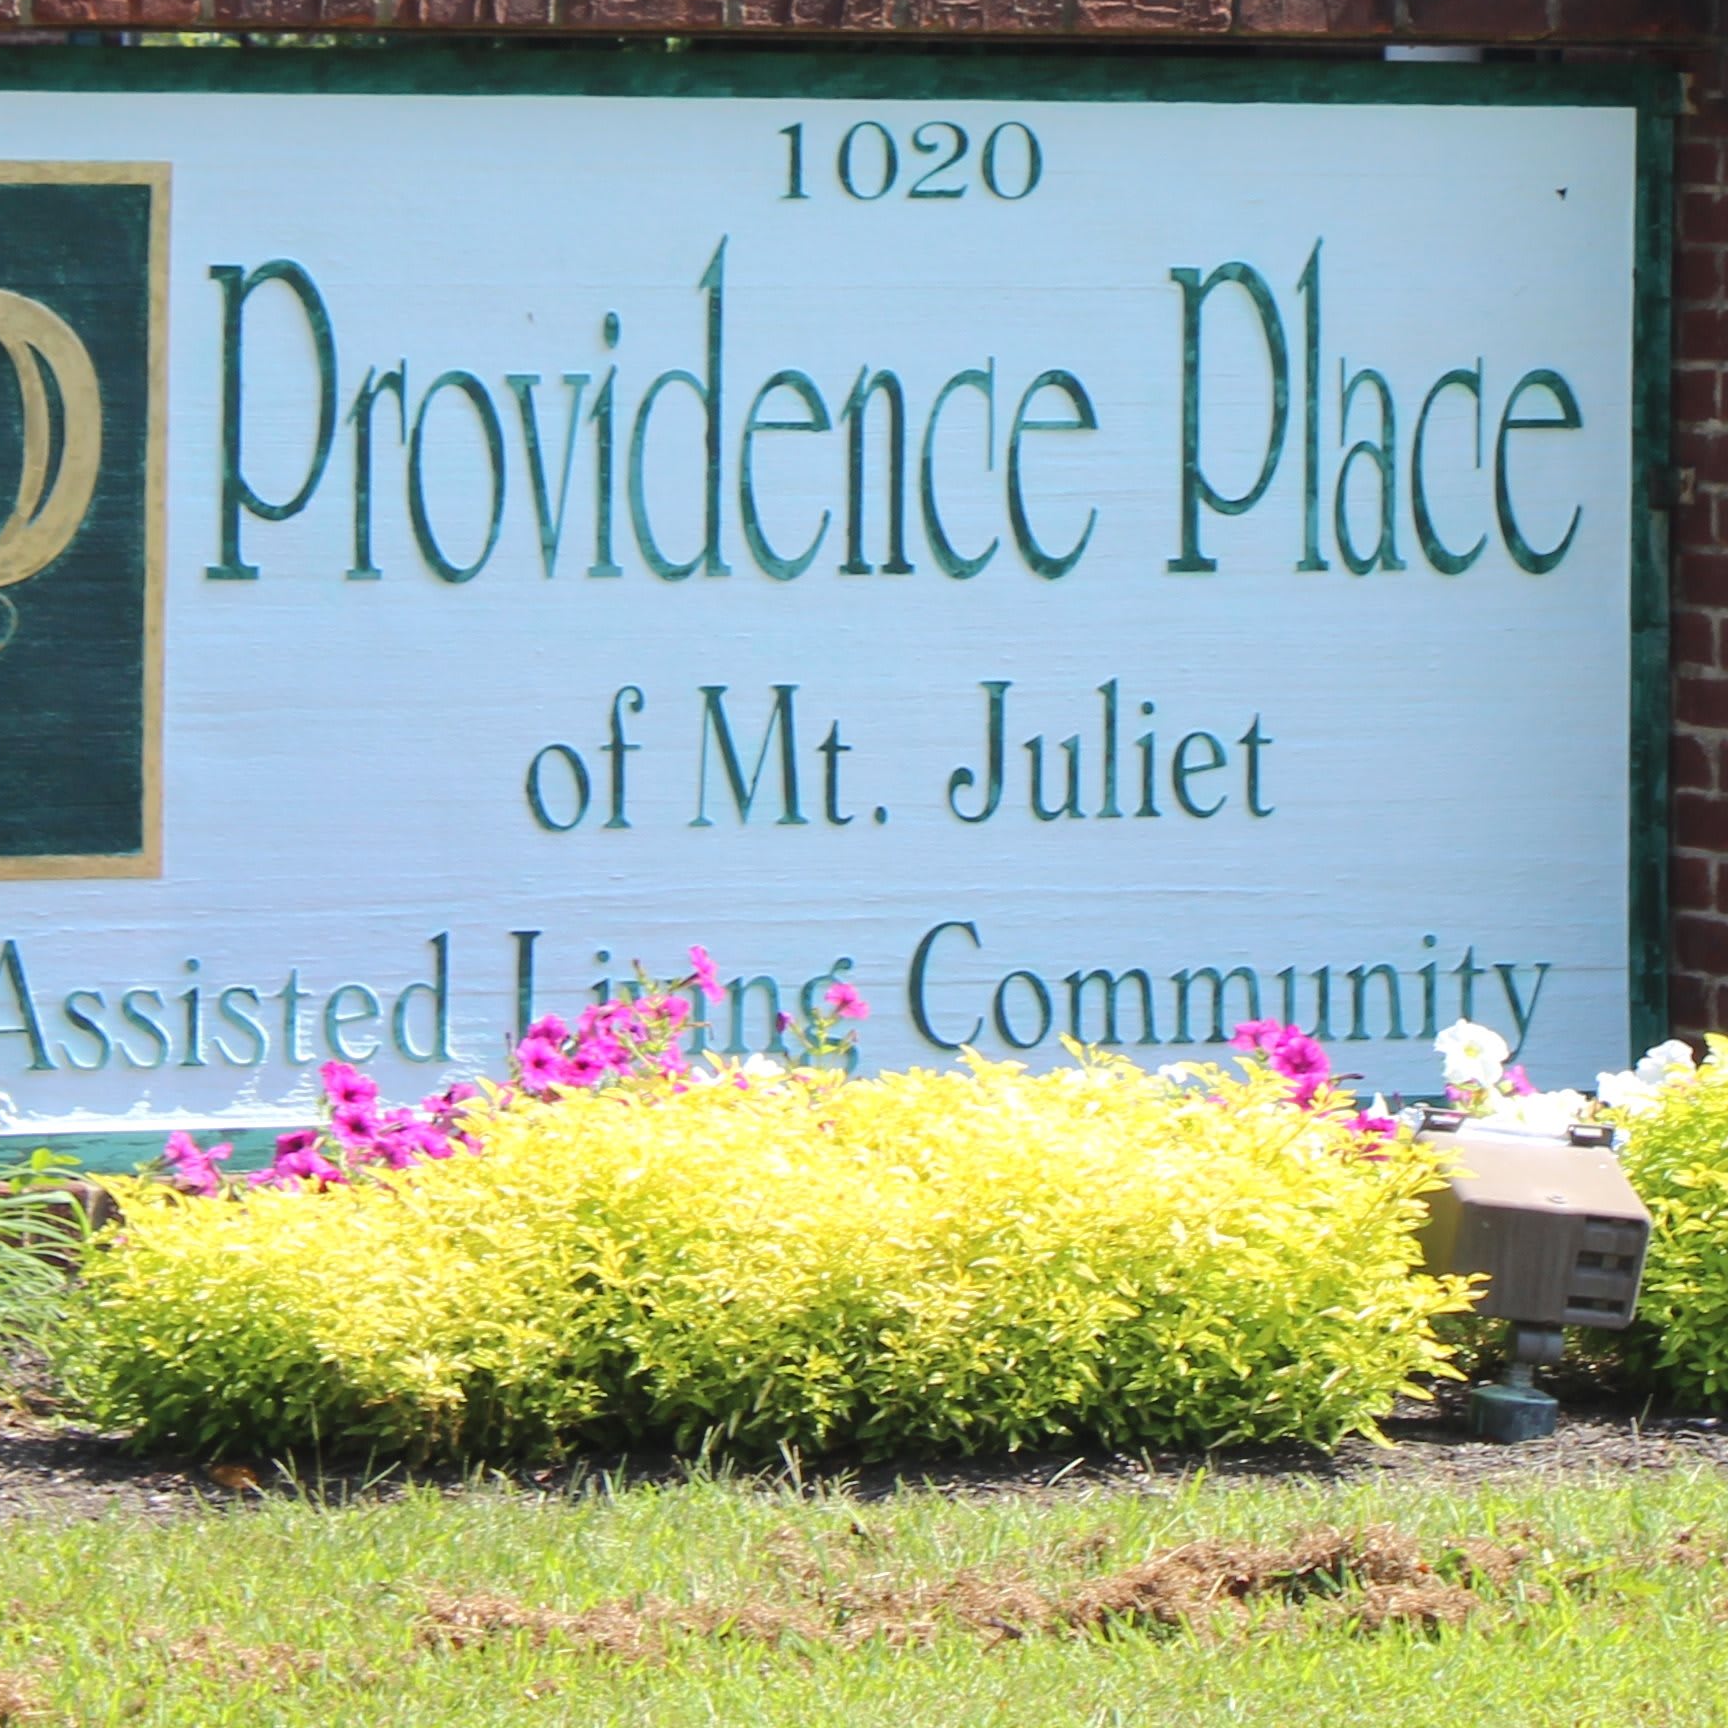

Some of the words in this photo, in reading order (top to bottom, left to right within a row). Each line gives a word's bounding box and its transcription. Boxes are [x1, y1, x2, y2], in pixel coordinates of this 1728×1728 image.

[779, 121, 1043, 201] 1020
[205, 234, 1099, 584] Providence
[1166, 235, 1584, 576] Place
[525, 684, 645, 832] of
[690, 683, 889, 827] Mt.
[947, 677, 1274, 824] Juliet
[907, 920, 1552, 1064] Community
